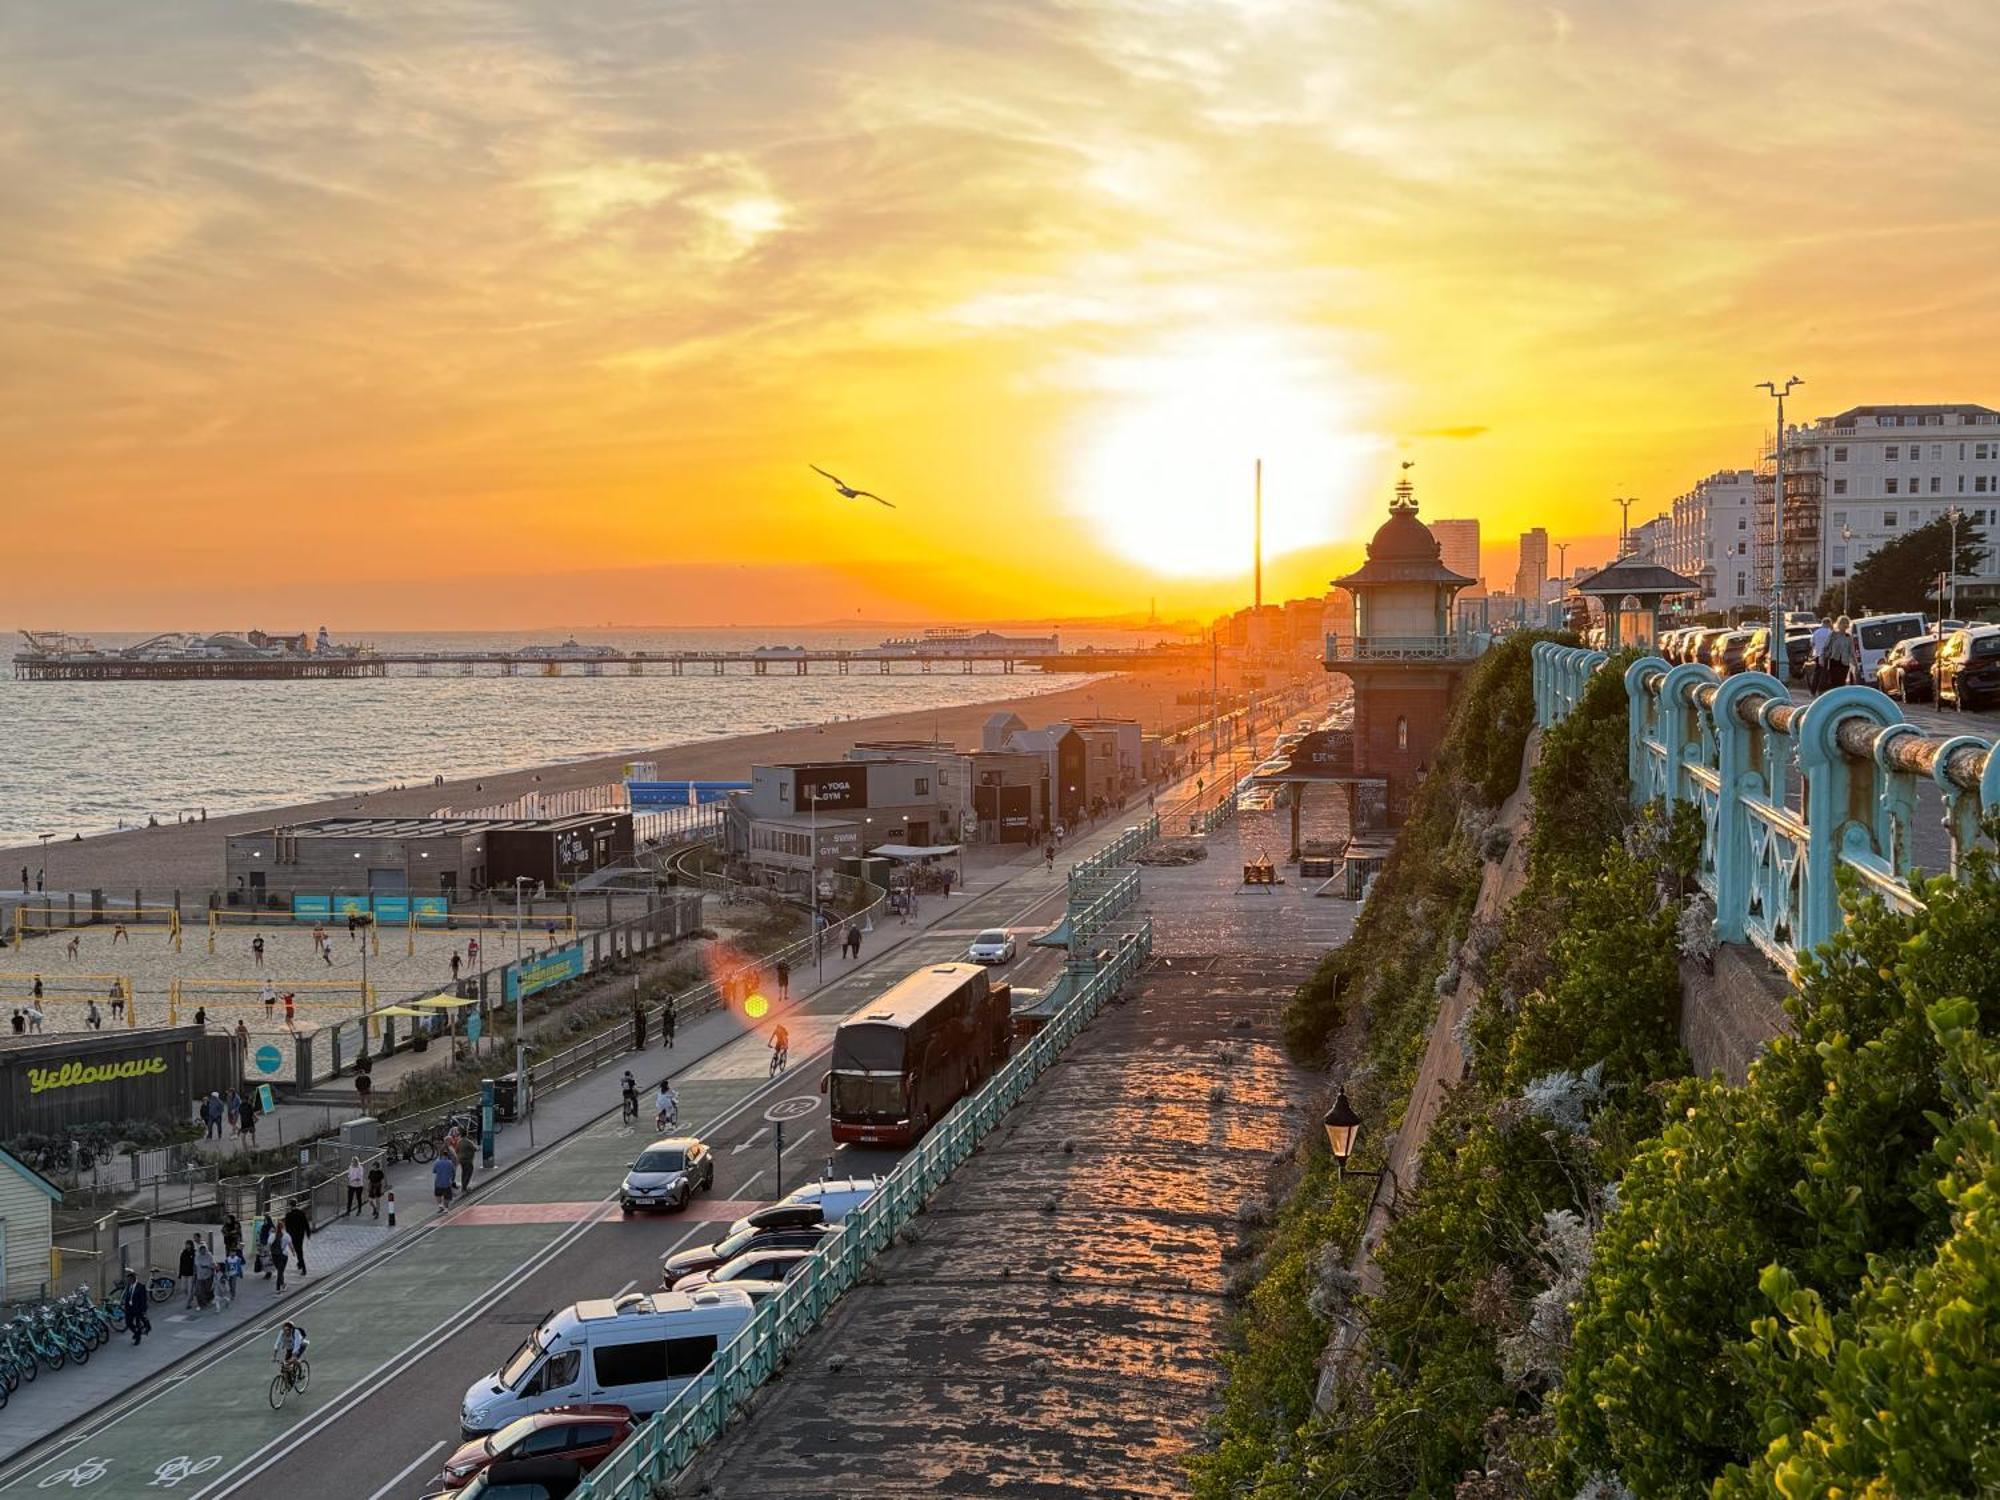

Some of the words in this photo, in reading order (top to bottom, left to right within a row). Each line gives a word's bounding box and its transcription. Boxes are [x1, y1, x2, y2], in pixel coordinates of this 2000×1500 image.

[828, 782, 850, 790] YOGA
[833, 833, 857, 842] SWIM
[820, 847, 839, 856] GYM
[28, 1057, 167, 1094] Yellowave
